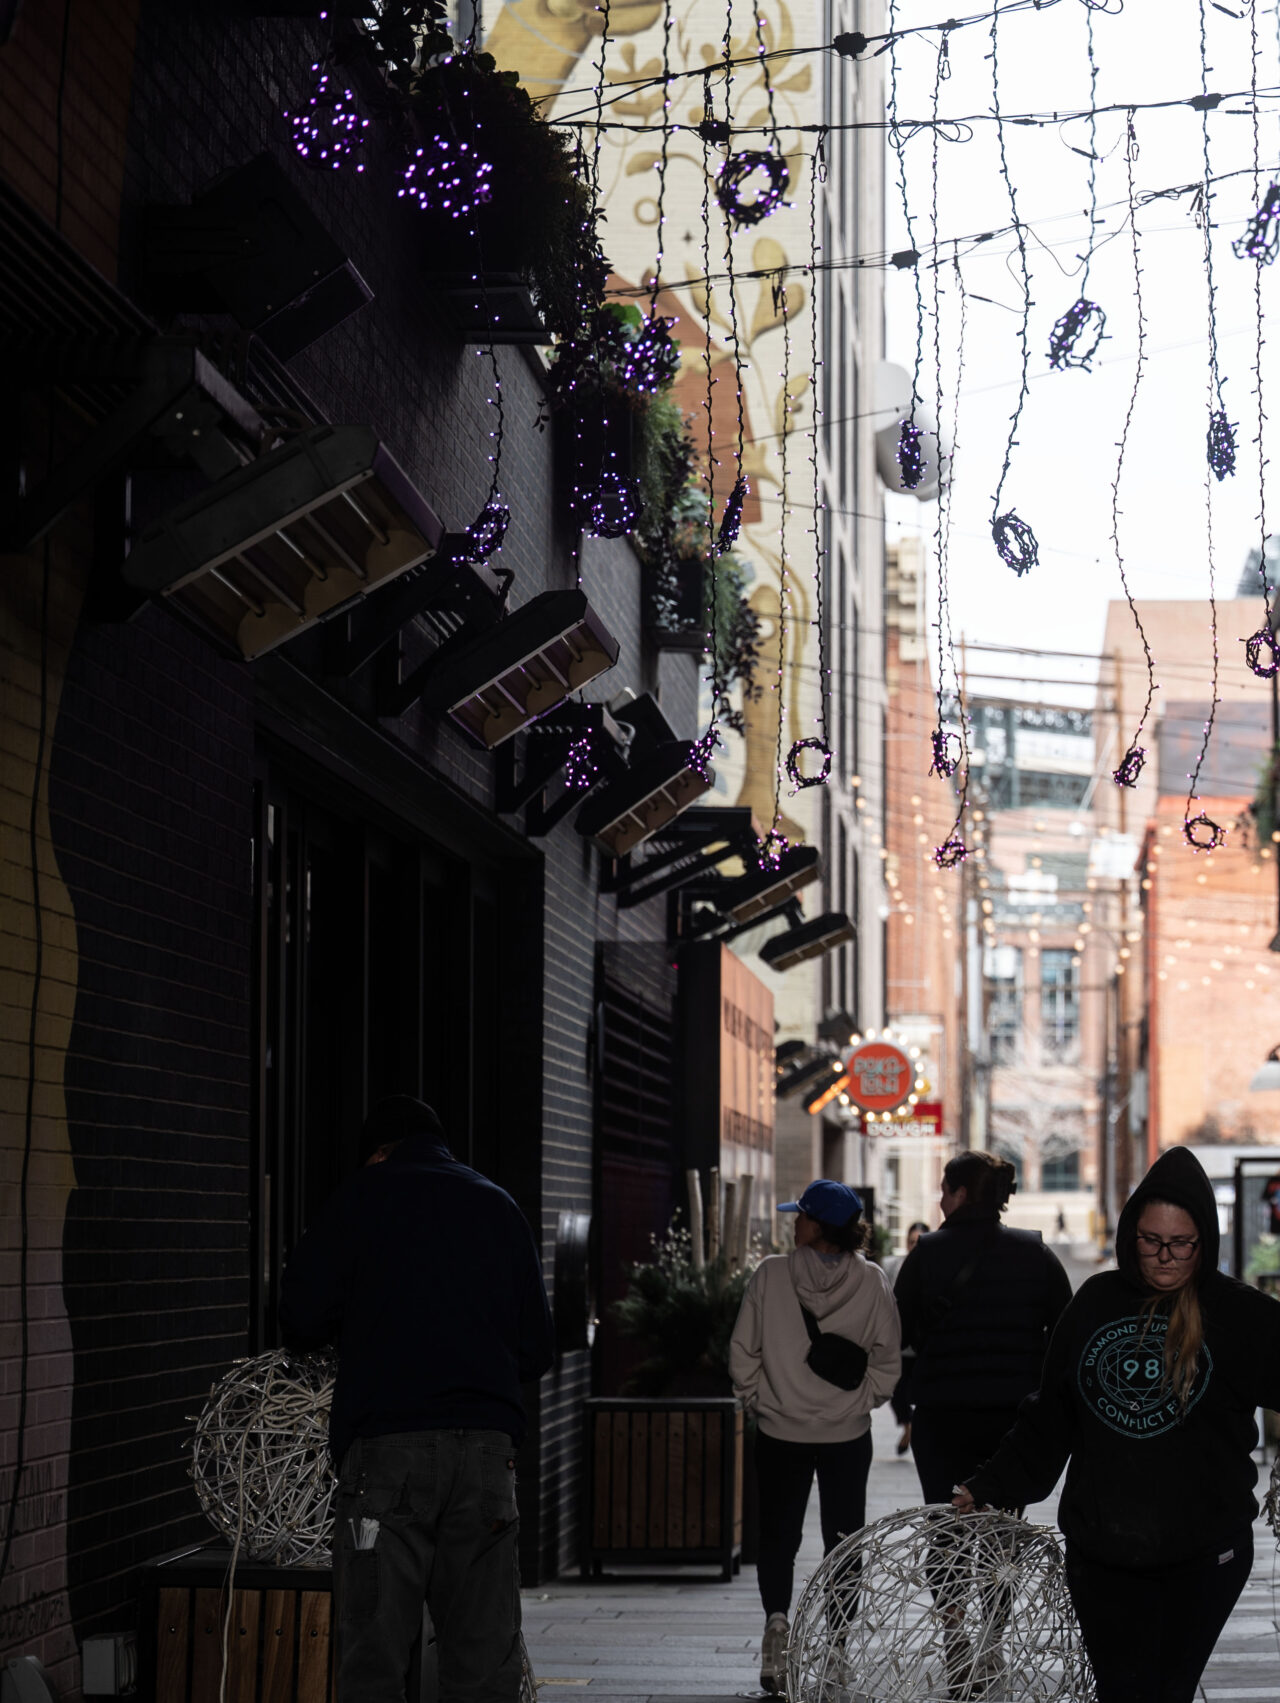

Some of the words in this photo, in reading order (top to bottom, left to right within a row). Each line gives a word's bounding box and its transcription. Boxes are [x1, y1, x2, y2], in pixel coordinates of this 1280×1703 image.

[1085, 1324, 1138, 1367] DIAMOND
[1123, 1359, 1160, 1381] 98
[1097, 1396, 1166, 1430] CONFLICT
